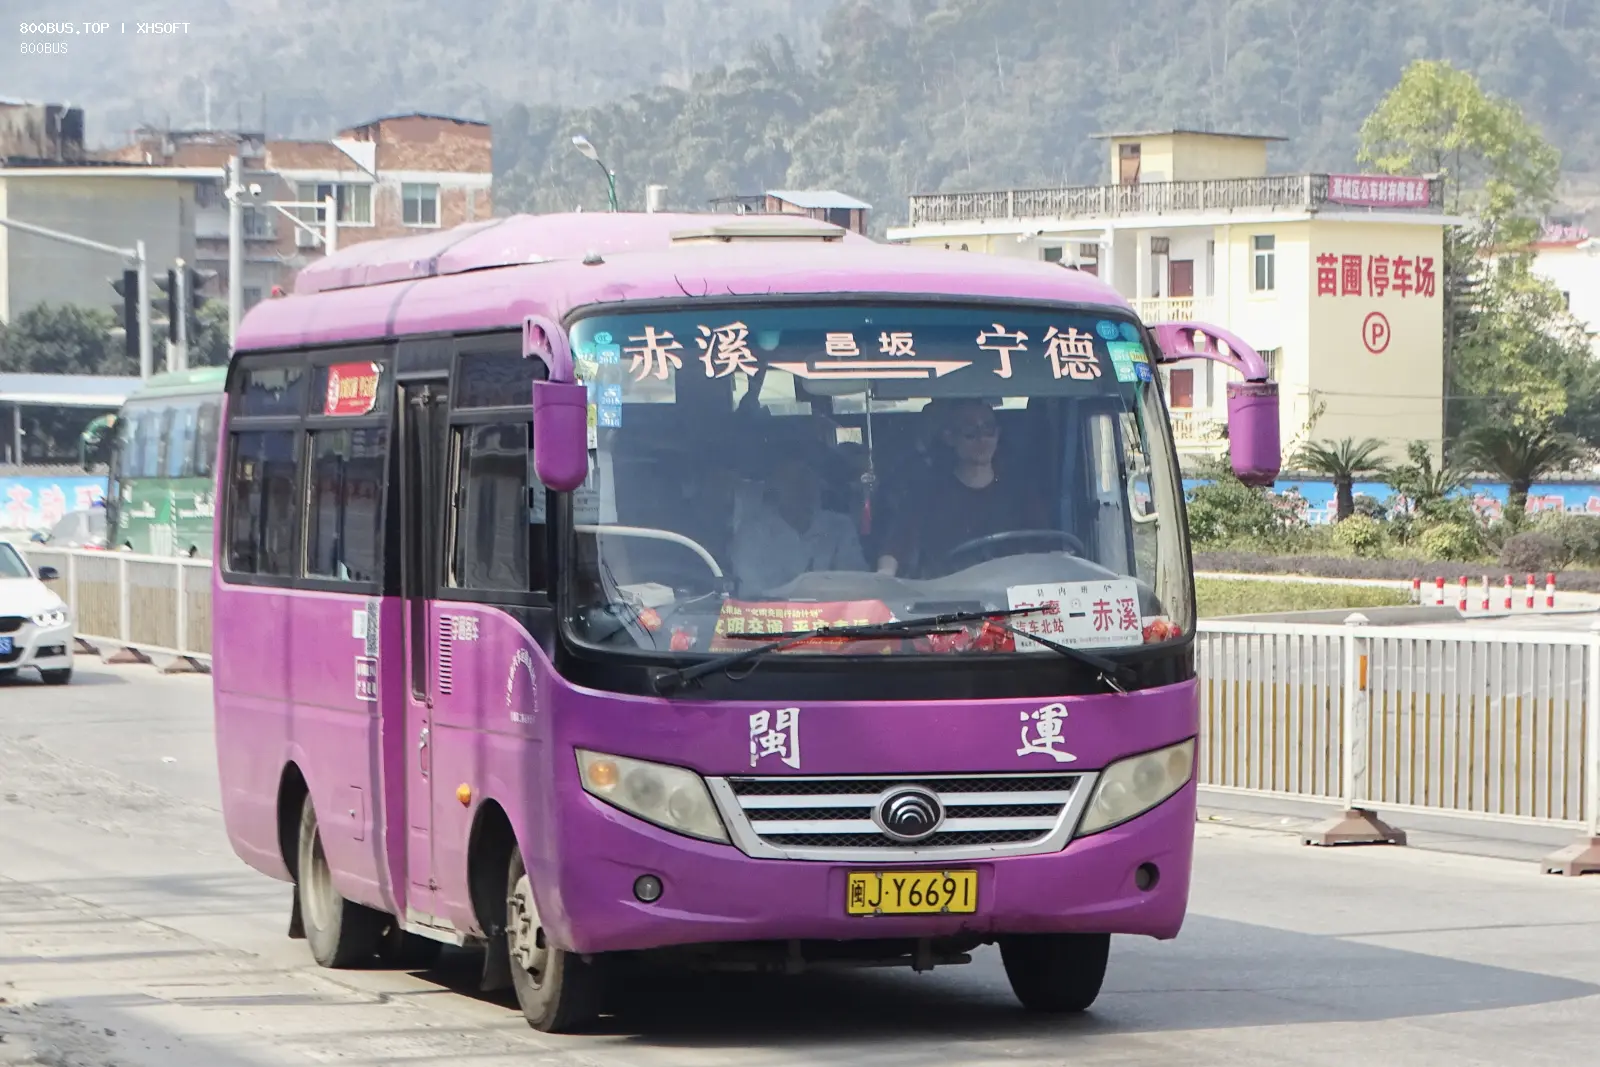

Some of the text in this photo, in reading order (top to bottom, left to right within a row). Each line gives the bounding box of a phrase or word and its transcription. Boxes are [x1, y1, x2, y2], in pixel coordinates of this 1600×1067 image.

[1316, 253, 1436, 298] 苗圃停车场
[623, 321, 1102, 382] 赤溪 邑坂 宁德
[1372, 323, 1385, 346] P
[1016, 618, 1065, 636] 汽车北站
[1092, 598, 1139, 632] 赤溪
[1016, 703, 1077, 763] 運
[850, 877, 970, 908] 闽J·Y6691
